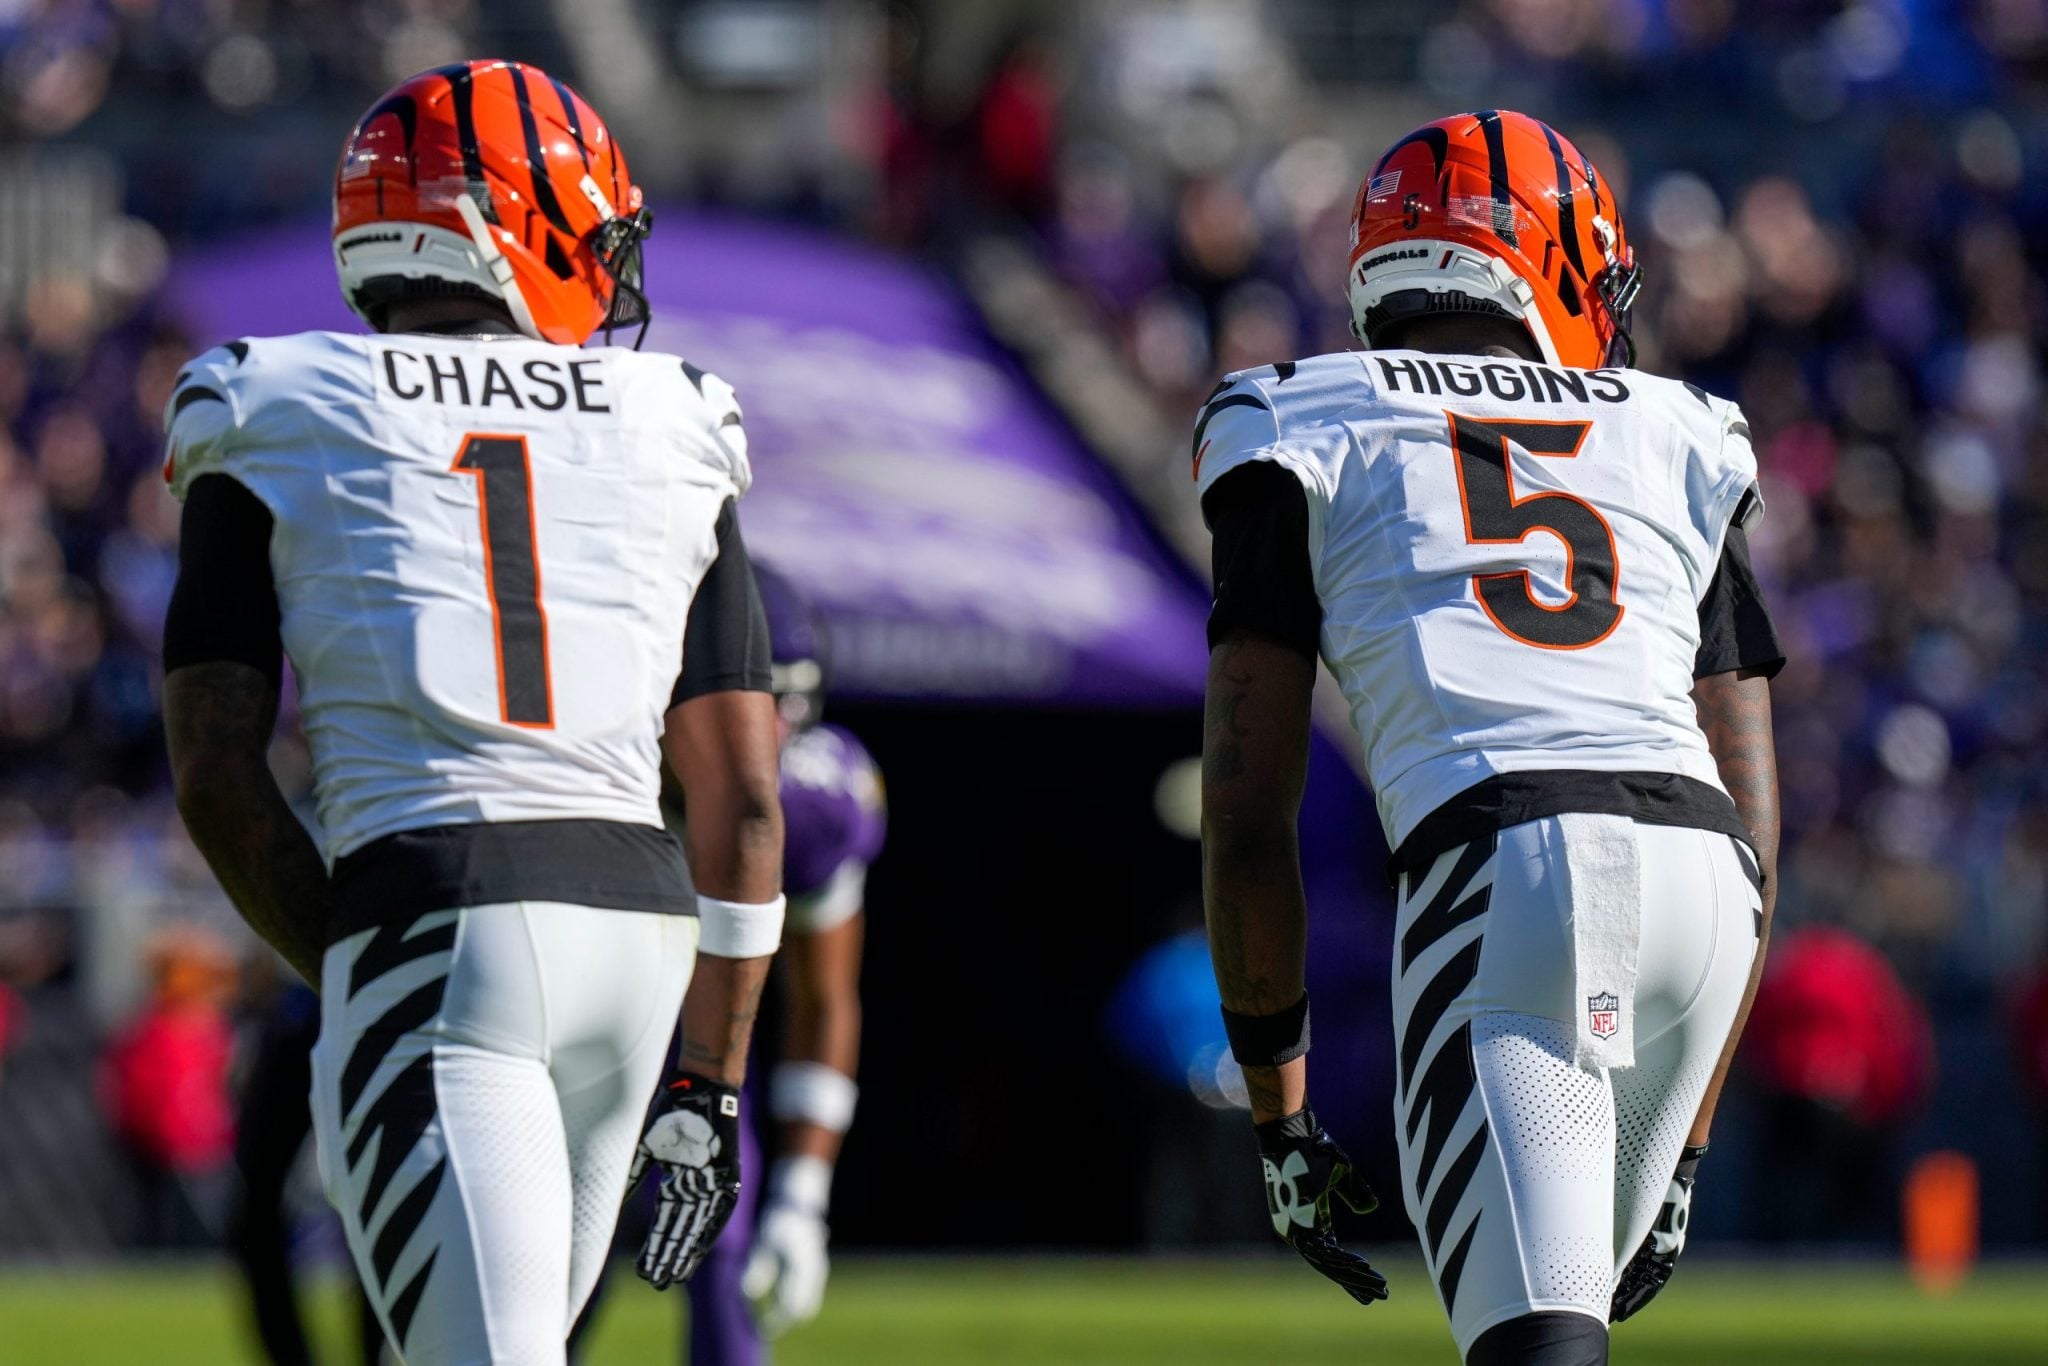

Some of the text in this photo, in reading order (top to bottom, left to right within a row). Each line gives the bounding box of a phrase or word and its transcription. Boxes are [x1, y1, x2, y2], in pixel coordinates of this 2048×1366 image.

[1403, 193, 1420, 232] 5
[1362, 249, 1428, 271] BENGALS
[383, 350, 610, 412] CHASE
[1375, 357, 1630, 403] HIGGINS
[1442, 409, 1625, 651] 5
[450, 432, 555, 729] 1
[1592, 1013, 1615, 1033] NFL
